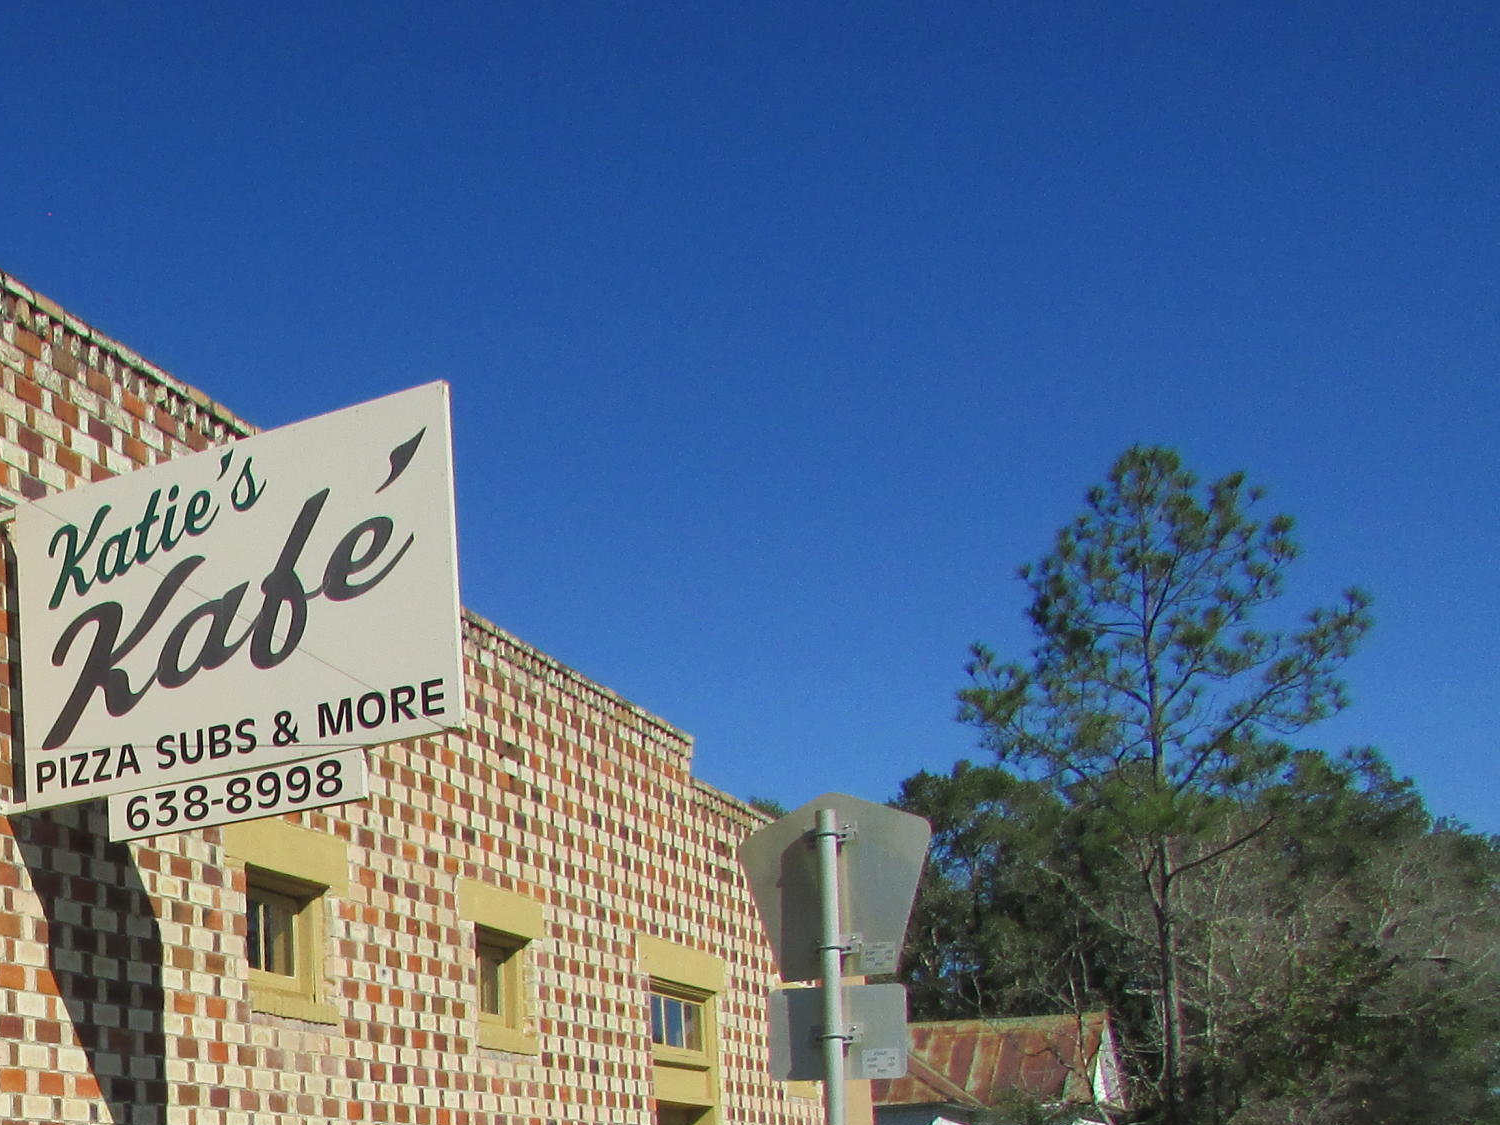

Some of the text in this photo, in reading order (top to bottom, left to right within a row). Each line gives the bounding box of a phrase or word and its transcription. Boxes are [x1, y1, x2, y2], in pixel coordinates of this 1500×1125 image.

[42, 426, 427, 751] Kafé
[47, 448, 267, 610] Katie's
[36, 679, 445, 793] PIZZA SUBS & MORE
[126, 760, 343, 831] 638-8998
